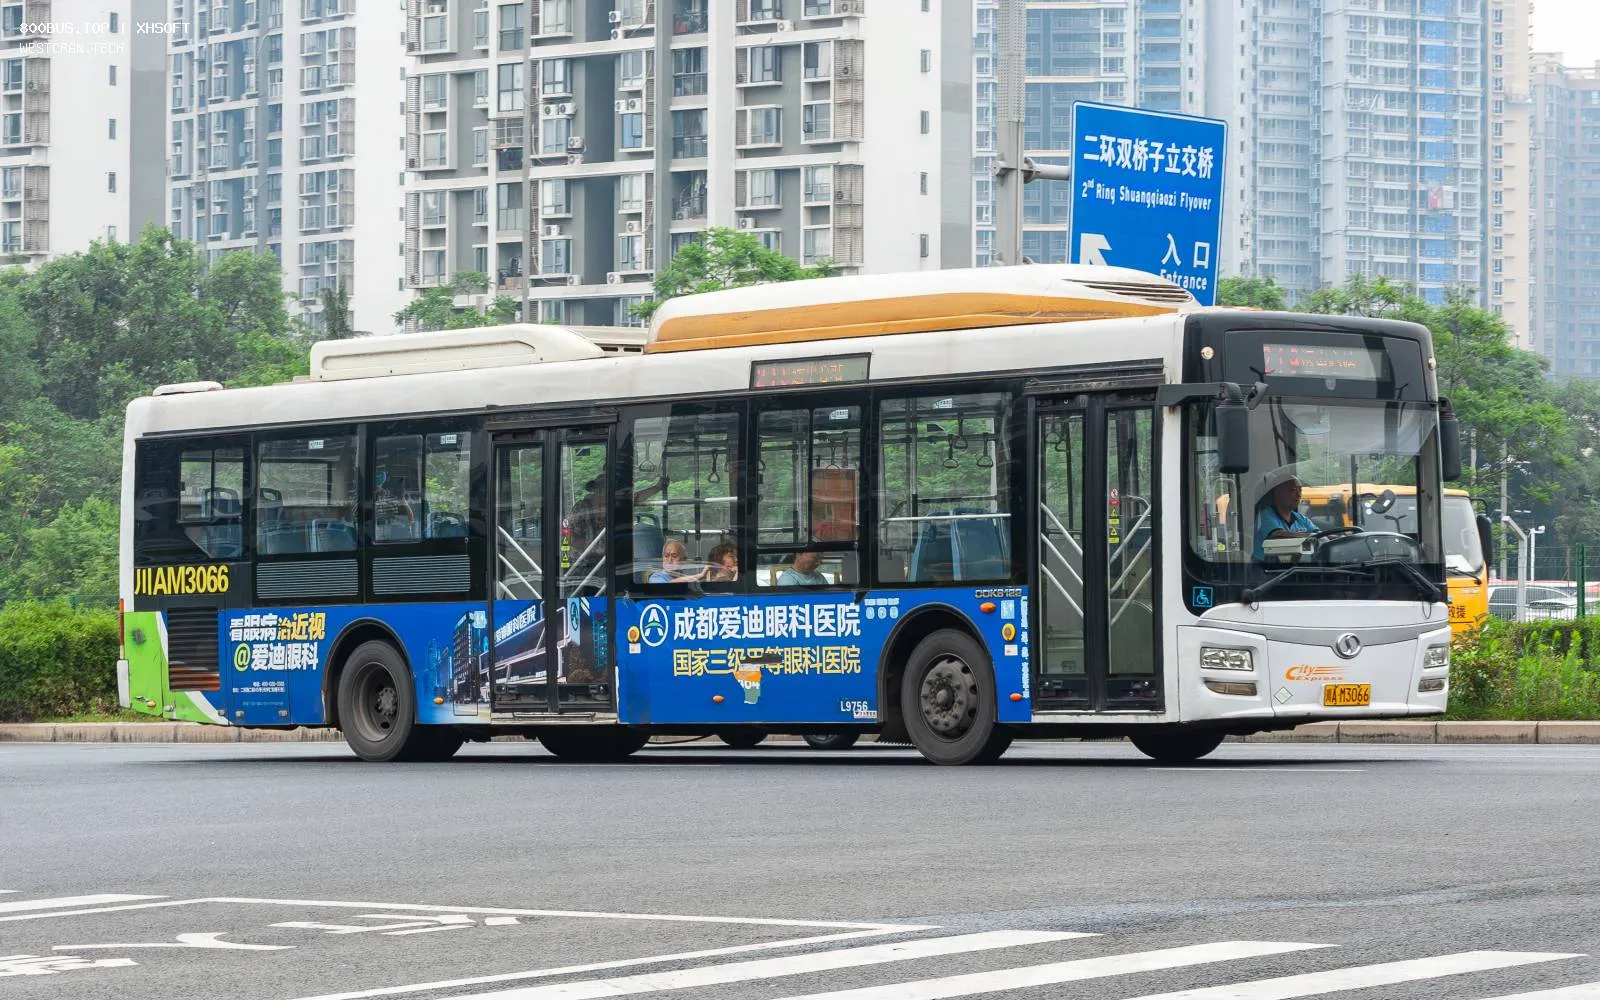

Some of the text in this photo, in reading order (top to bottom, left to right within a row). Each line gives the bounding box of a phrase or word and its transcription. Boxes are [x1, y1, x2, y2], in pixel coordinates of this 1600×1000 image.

[1083, 134, 1214, 180] 二环双桥子立交桥
[1081, 178, 1212, 213] 2nd Ring Shuangqiaozi Flyover
[1160, 232, 1211, 270] 入口
[134, 564, 229, 596] 川AM3066
[230, 612, 326, 641] 看眼病治近视
[673, 603, 861, 641] 成都爱迪眼科医院
[234, 642, 319, 673] @爱迪眼科
[840, 700, 869, 712] L9756
